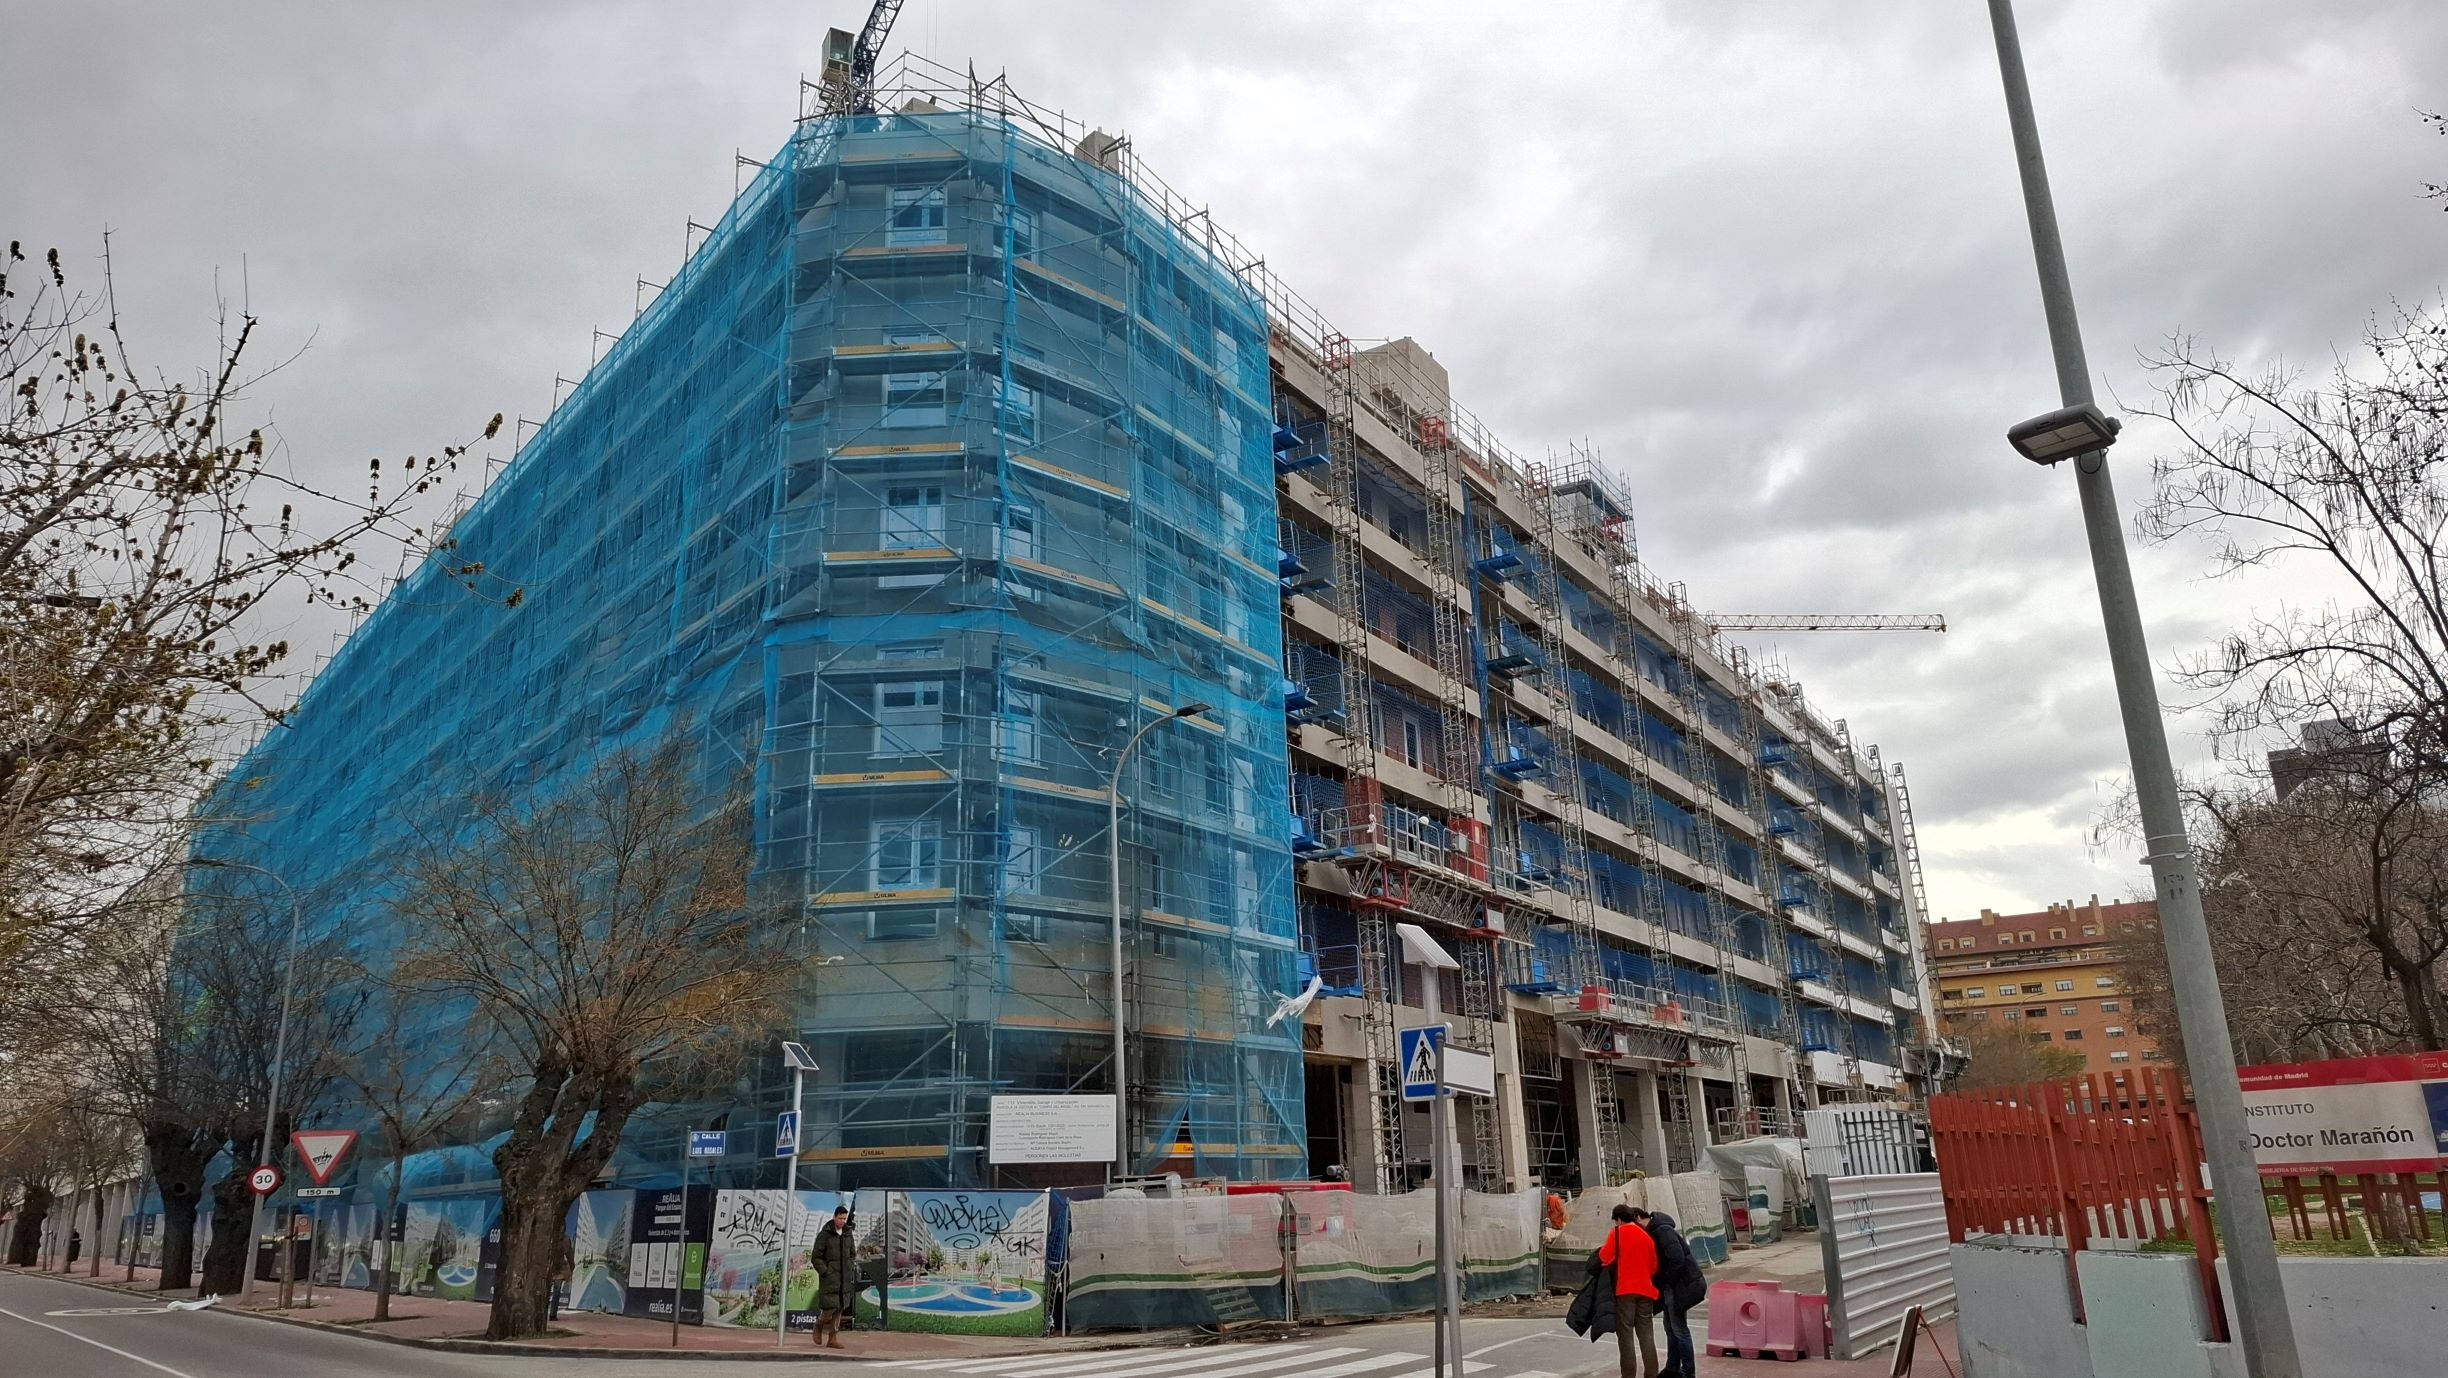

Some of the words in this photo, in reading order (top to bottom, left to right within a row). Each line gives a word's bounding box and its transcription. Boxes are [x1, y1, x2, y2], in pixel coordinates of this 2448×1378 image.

[2239, 1075, 2273, 1083] omunidad
[2283, 1071, 2309, 1080] Madrid
[2244, 1103, 2315, 1117] NSTITUTO
[2250, 1132, 2314, 1149] Doctor
[2320, 1125, 2414, 1146] Marañón
[255, 1174, 273, 1185] 30
[648, 1299, 673, 1314] realia.es
[791, 1314, 796, 1323] 2
[796, 1313, 817, 1324] pistas
